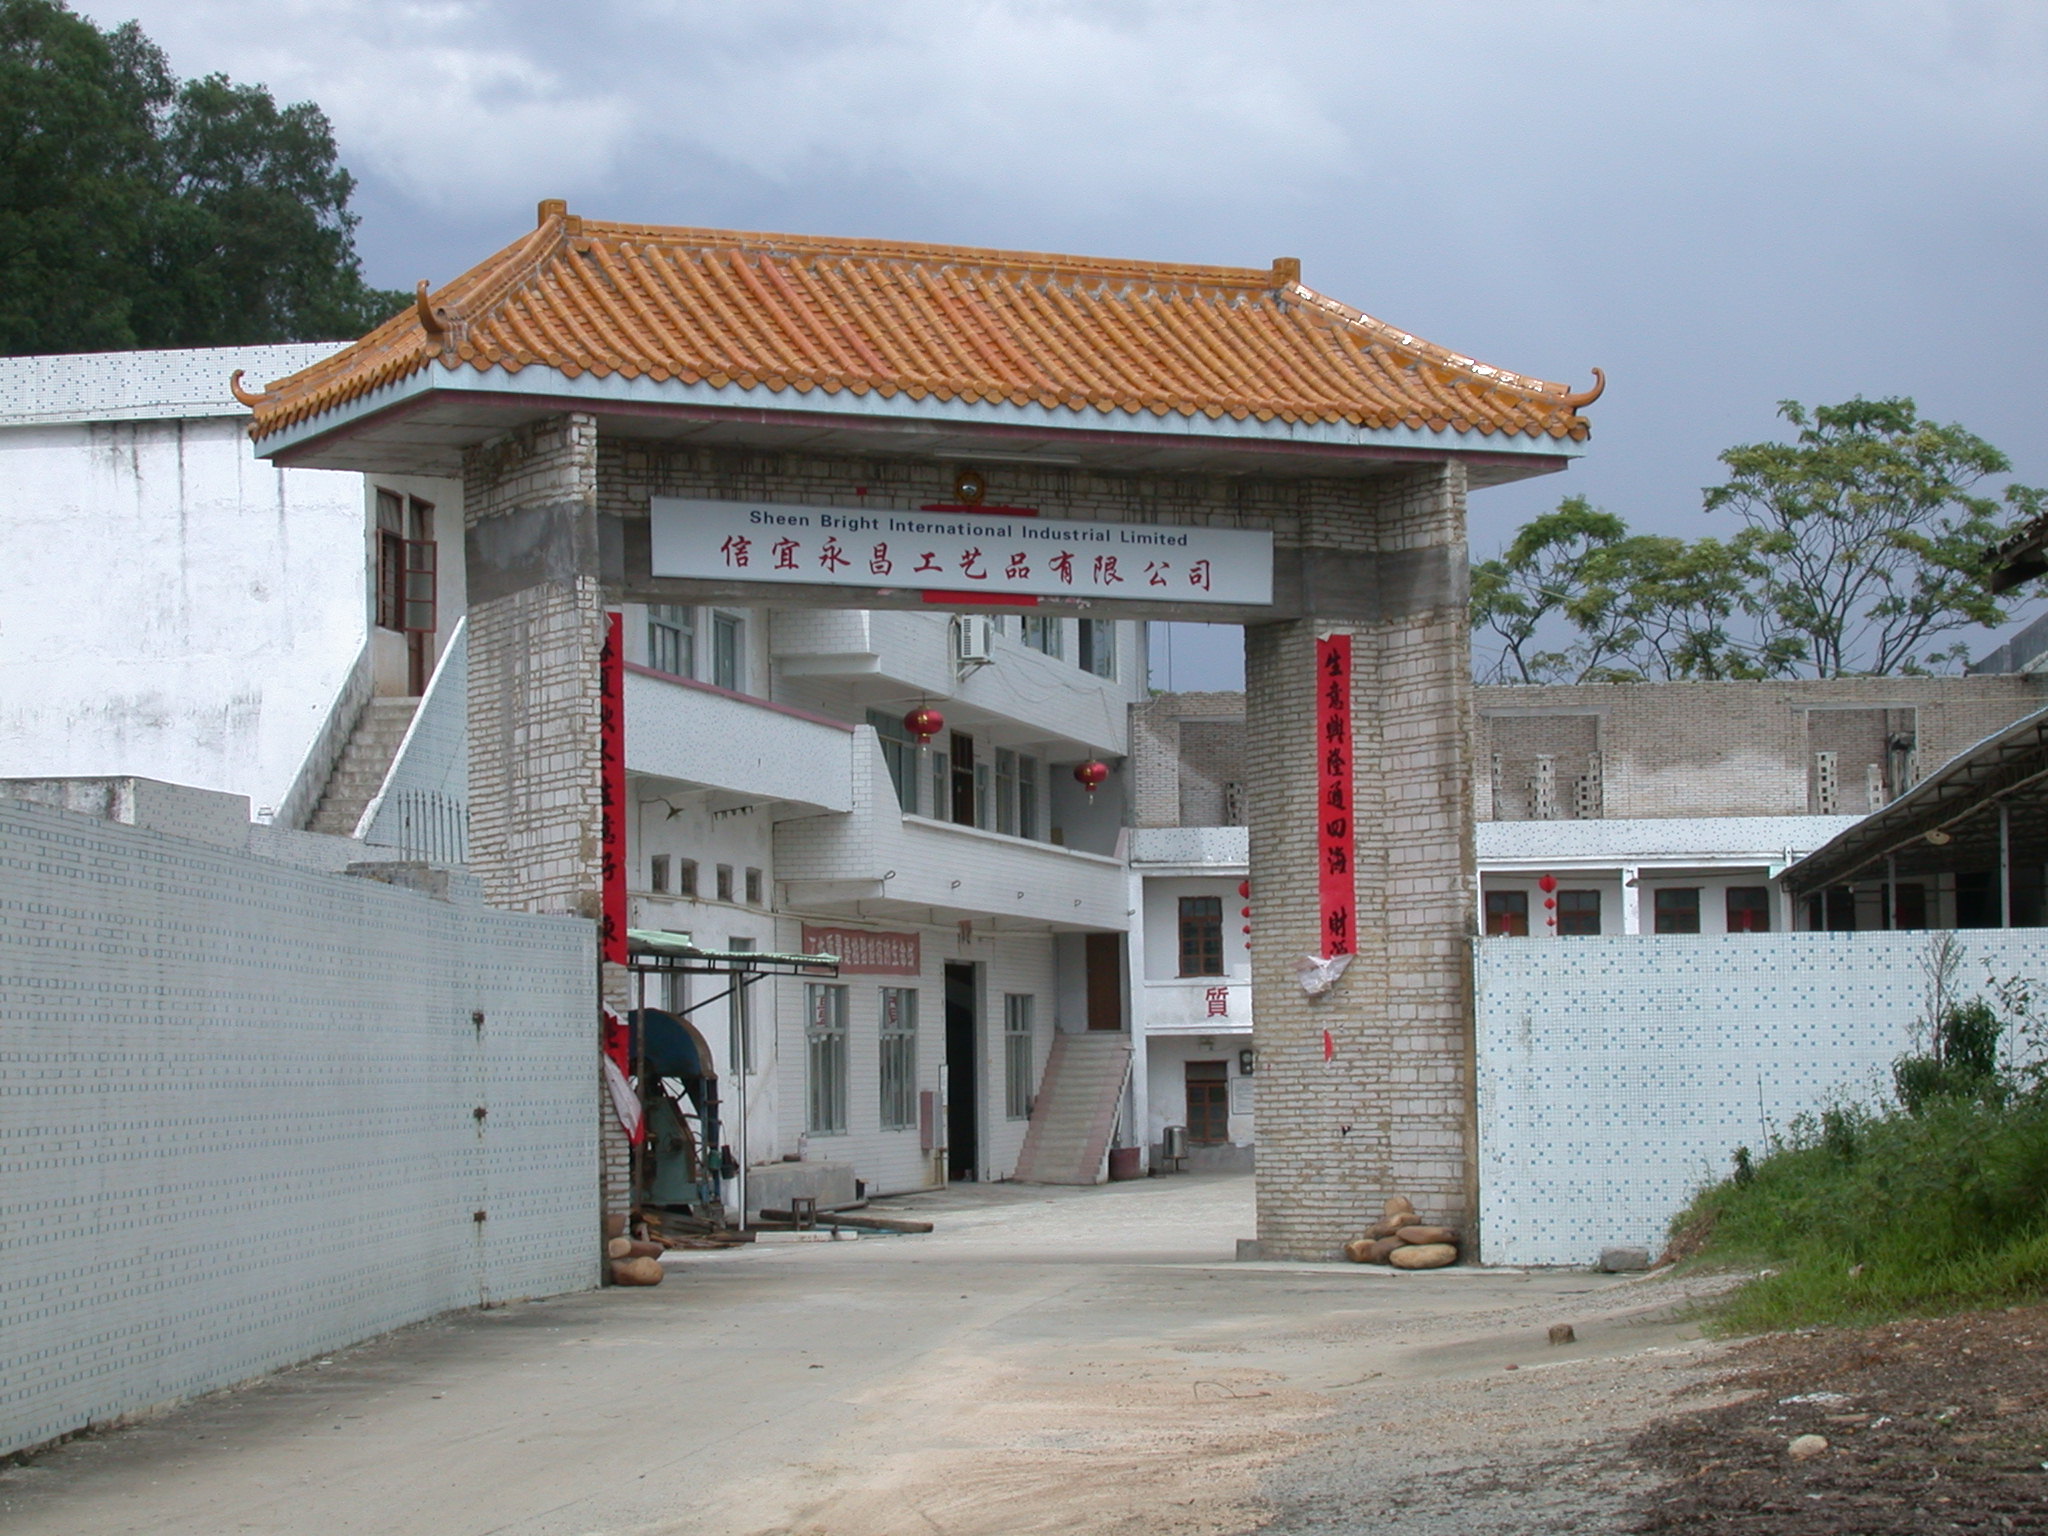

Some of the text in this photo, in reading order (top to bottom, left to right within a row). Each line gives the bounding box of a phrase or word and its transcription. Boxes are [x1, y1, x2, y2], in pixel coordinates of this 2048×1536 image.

[750, 510, 1188, 547] Sheen Bright International Industrial Limited
[720, 535, 1210, 592] 信宜永昌工艺品有限公司
[1205, 986, 1229, 1018] 質
